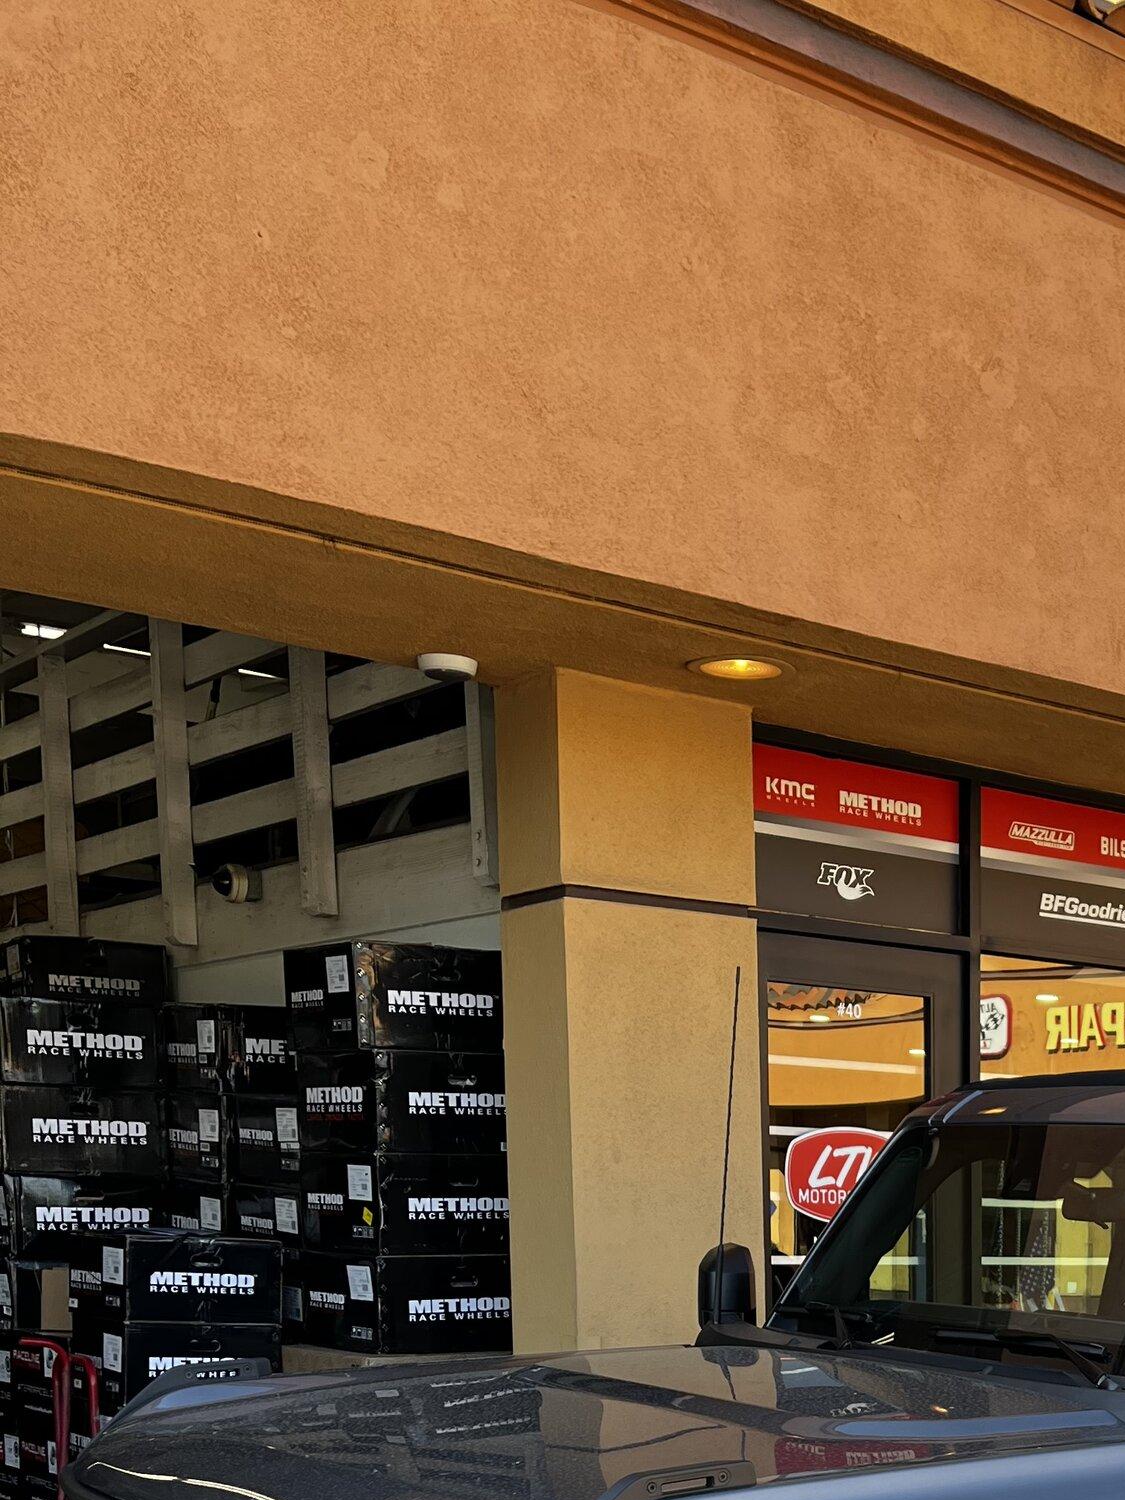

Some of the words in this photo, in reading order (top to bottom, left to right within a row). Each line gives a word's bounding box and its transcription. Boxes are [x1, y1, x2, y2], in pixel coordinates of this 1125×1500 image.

[839, 790, 922, 818] METHOD
[840, 806, 869, 818] RACE
[875, 811, 922, 827] WHEELS
[1011, 824, 1073, 845] MAZZULLA
[817, 862, 874, 897] FOX
[47, 973, 141, 991] METHOD
[49, 985, 82, 994] RACE
[90, 988, 140, 998] WHEELS
[291, 989, 324, 1003] METHOD
[387, 989, 494, 1009] METHOD
[388, 1004, 427, 1015] RACE
[435, 1007, 494, 1018] WHEELS
[837, 1002, 862, 1019] #40
[26, 1029, 143, 1051] METHOD
[27, 1045, 71, 1056] RACE
[79, 1048, 144, 1060] WHEELS
[245, 1053, 287, 1064] RACE
[306, 1086, 363, 1104] METHOD
[306, 1104, 325, 1113] RACE
[328, 1104, 363, 1113] WHEELS
[408, 1106, 446, 1116] RACE
[32, 1118, 147, 1136] METHOD
[240, 1128, 274, 1141] METHOD
[32, 1134, 76, 1144] RACE
[83, 1135, 148, 1146] WHEELS
[307, 1193, 344, 1205] METHOD
[799, 1188, 850, 1205] MOTOR
[408, 1197, 510, 1212] METHOD
[35, 1207, 151, 1223] METHOD
[241, 1215, 274, 1230] METHOD
[408, 1212, 446, 1220] RACE
[453, 1212, 510, 1220] WHEELS
[37, 1223, 79, 1231] RACE
[149, 1271, 255, 1288] METHOD
[149, 1285, 189, 1294] RACE
[196, 1286, 255, 1296] WHEELS
[309, 1290, 345, 1305] METHOD
[408, 1297, 511, 1314] METHOD
[408, 1313, 446, 1322] RACE
[453, 1310, 510, 1321] WHEELS
